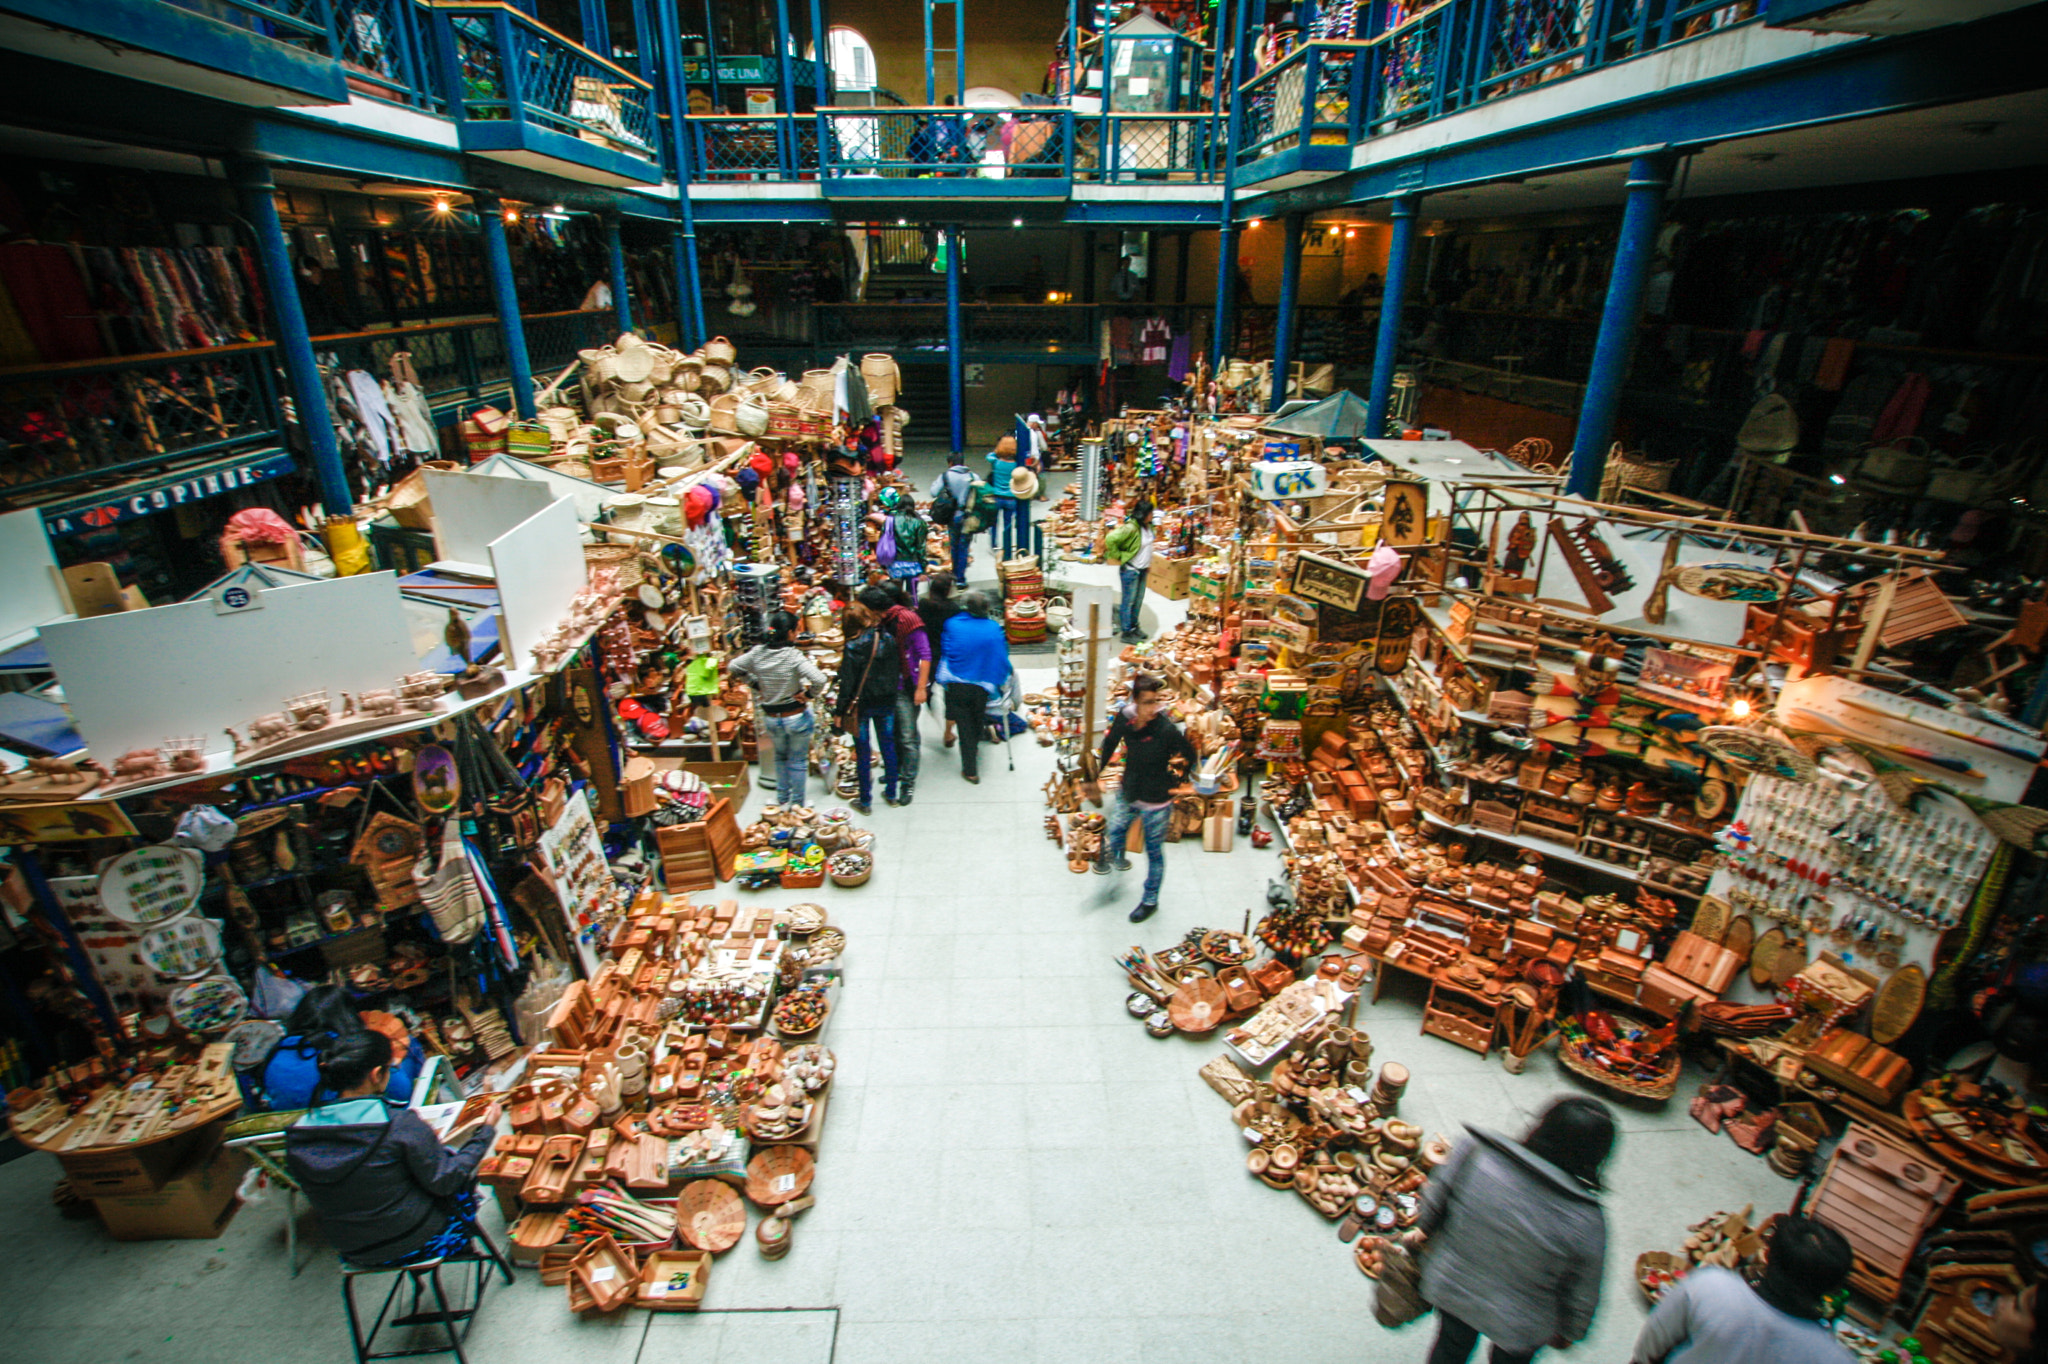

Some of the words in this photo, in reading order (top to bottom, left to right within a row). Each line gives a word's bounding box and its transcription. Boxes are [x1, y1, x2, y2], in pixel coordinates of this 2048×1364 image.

[701, 68, 737, 80] DNDE
[738, 68, 761, 80] LINA
[129, 466, 255, 515] COPIHUE
